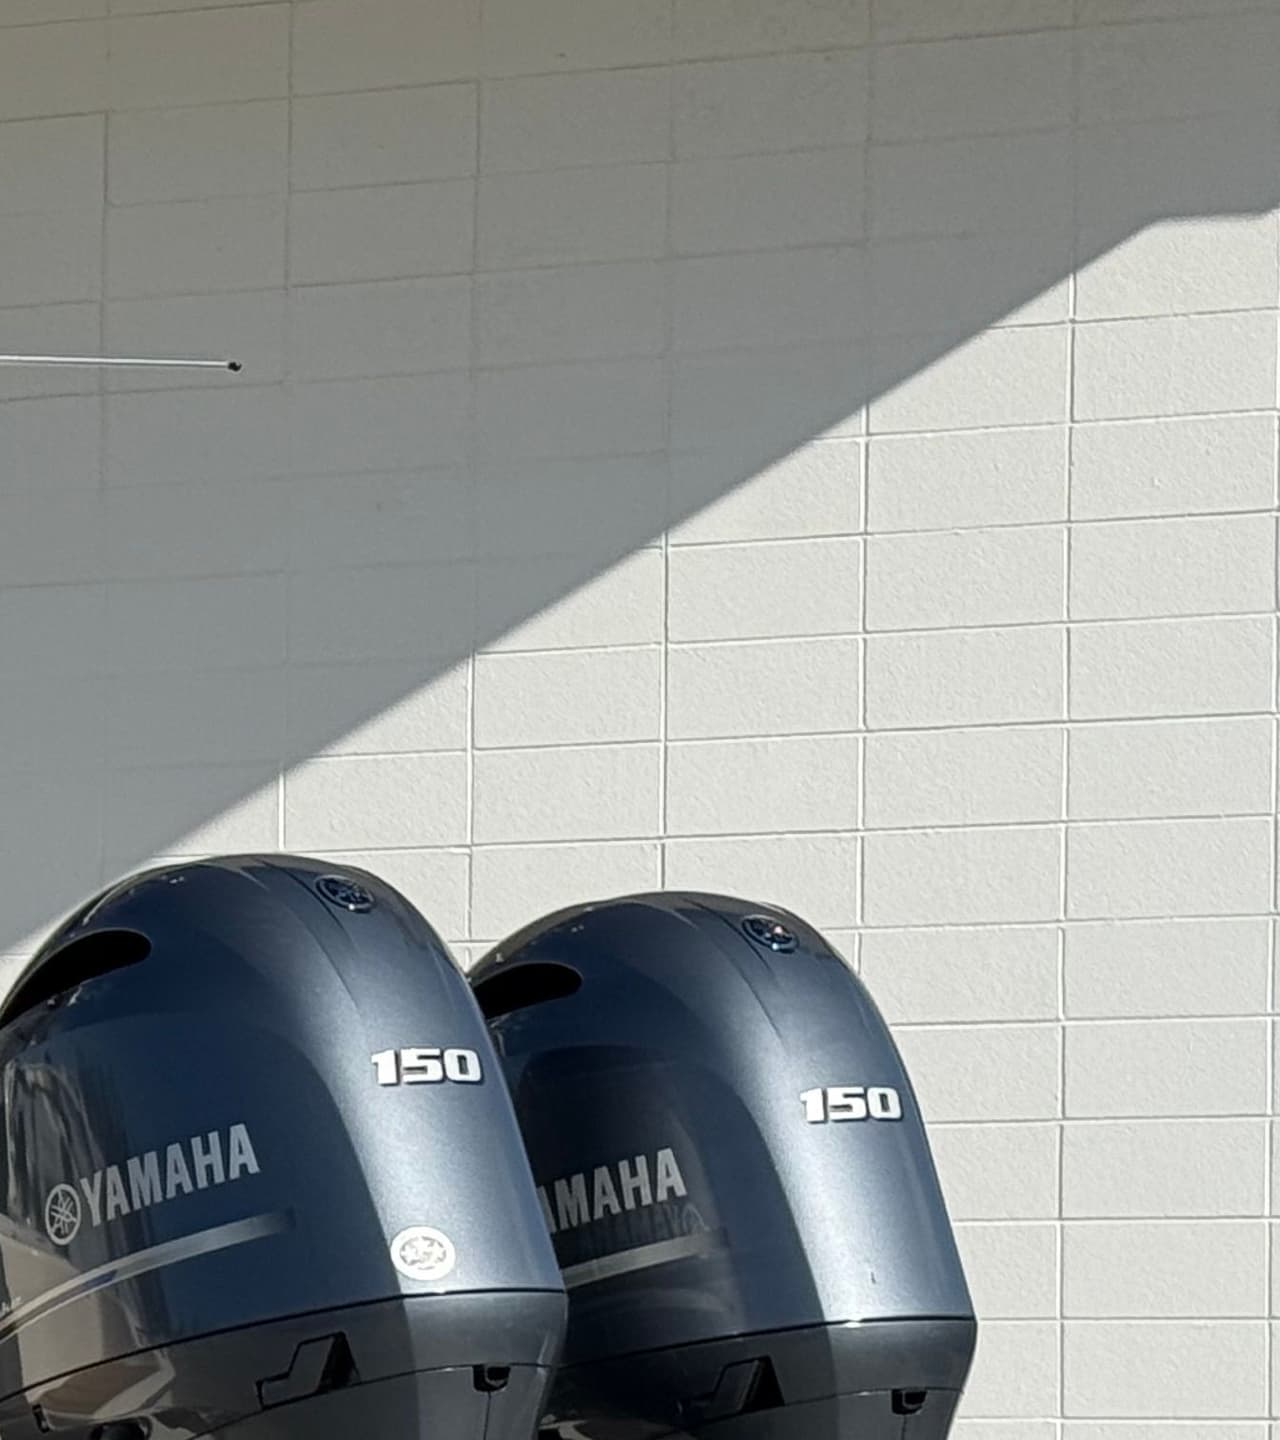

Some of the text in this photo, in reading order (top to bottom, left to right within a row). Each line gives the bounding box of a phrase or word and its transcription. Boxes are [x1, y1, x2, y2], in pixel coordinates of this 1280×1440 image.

[371, 1048, 482, 1086] 150
[799, 1087, 903, 1123] 150
[80, 1122, 260, 1227] YAMAHA
